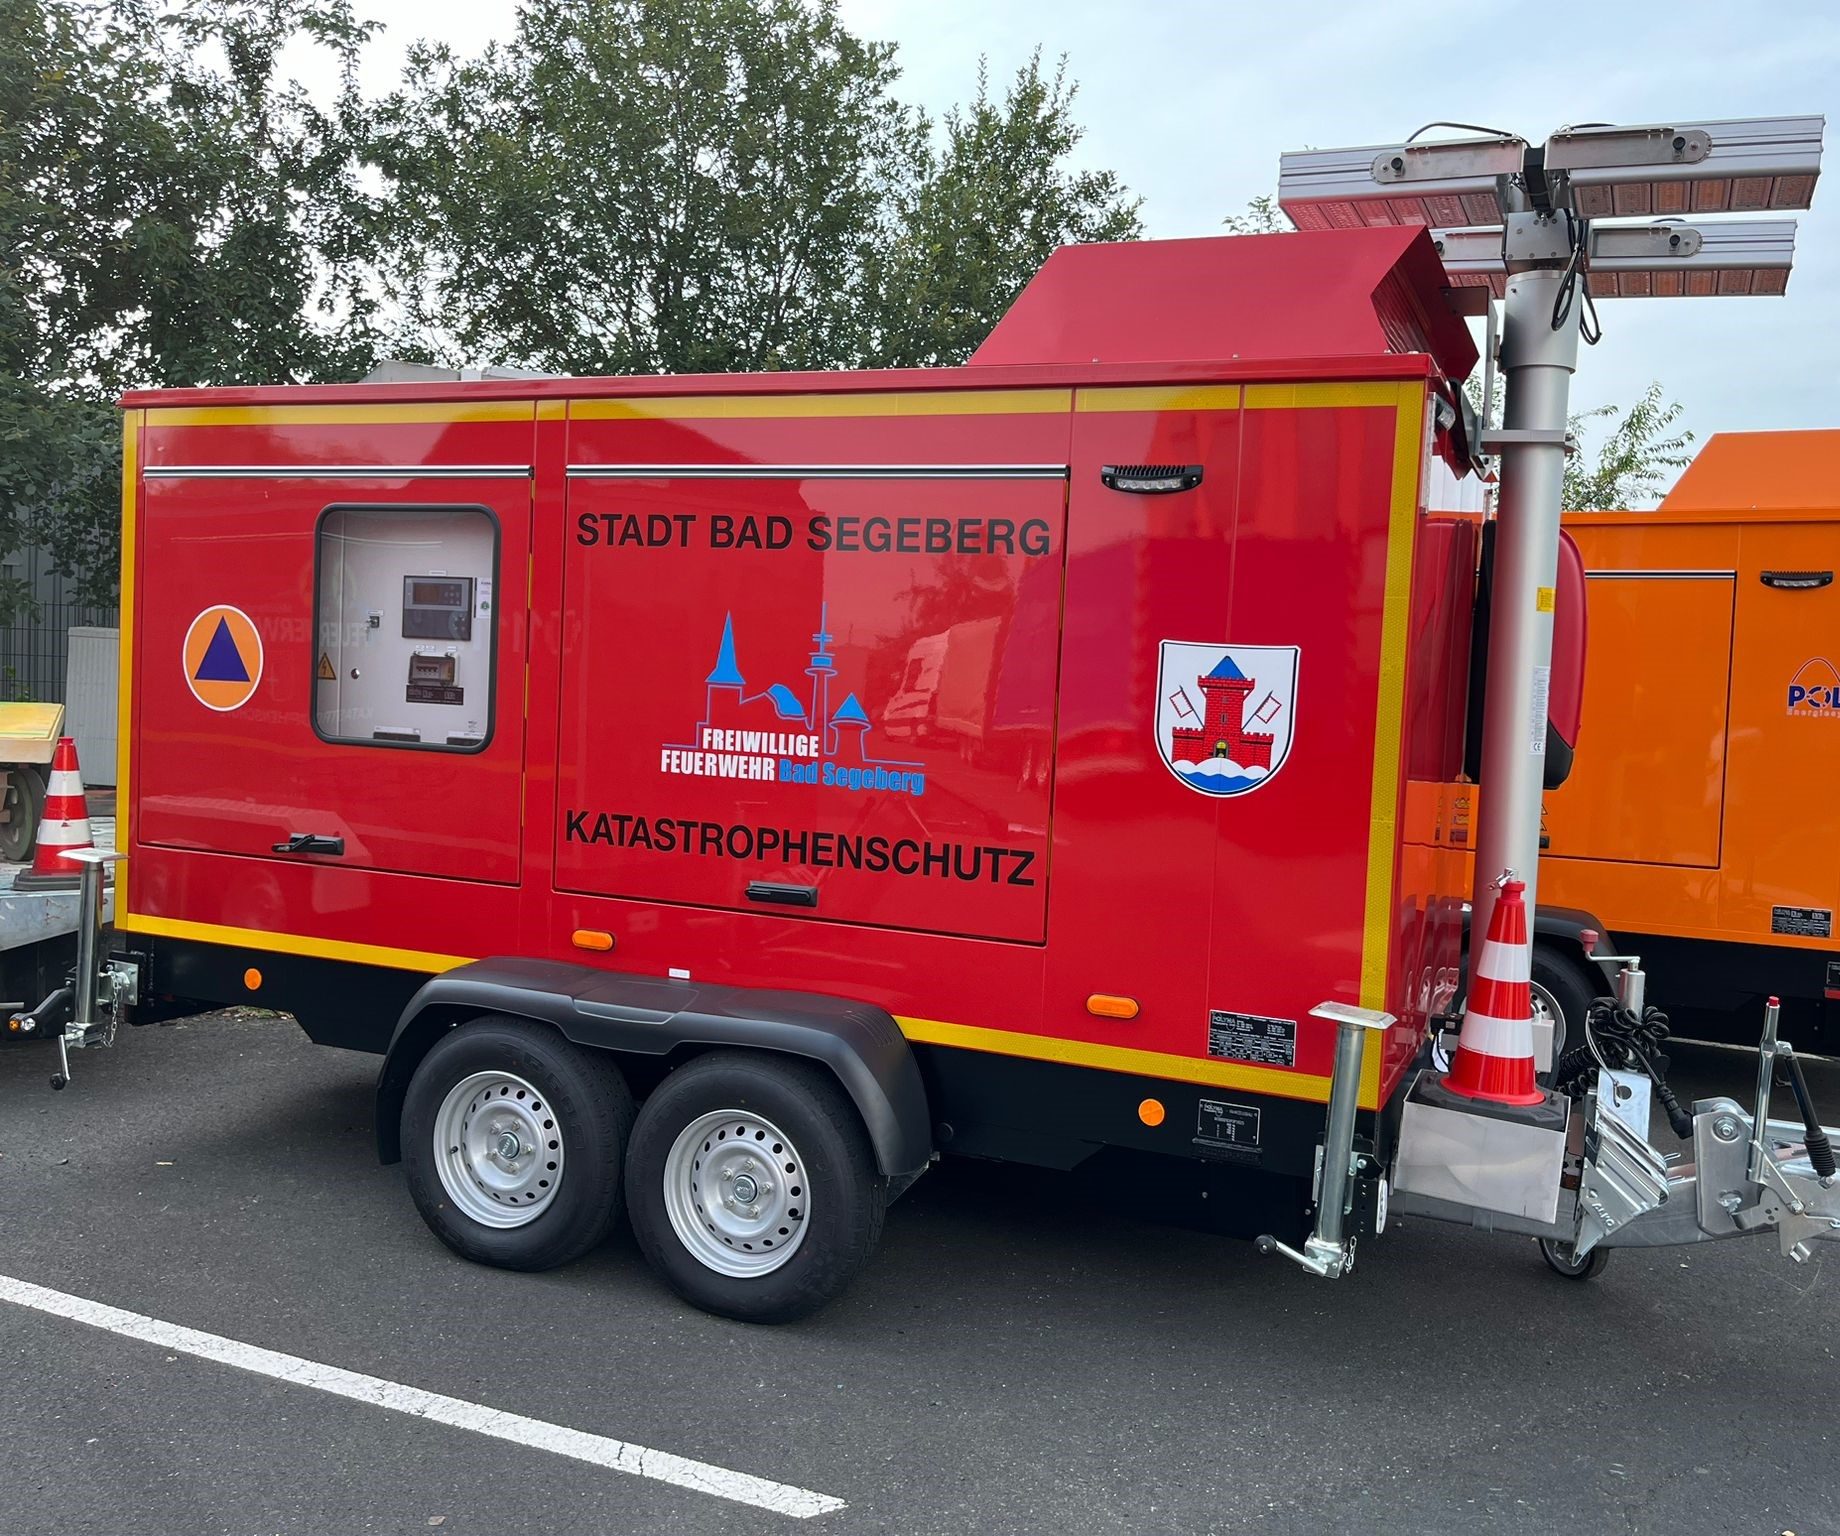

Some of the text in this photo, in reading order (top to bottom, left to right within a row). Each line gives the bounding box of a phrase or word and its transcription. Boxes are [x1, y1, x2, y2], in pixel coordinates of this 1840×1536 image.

[577, 513, 1051, 556] STADT BAD SEGEBERG
[702, 728, 819, 758] FREIWILLIGE
[660, 749, 925, 795] FEUERWEHR Bad Segeberg
[566, 810, 1035, 886] KATASTROPHENSCHUTZ
